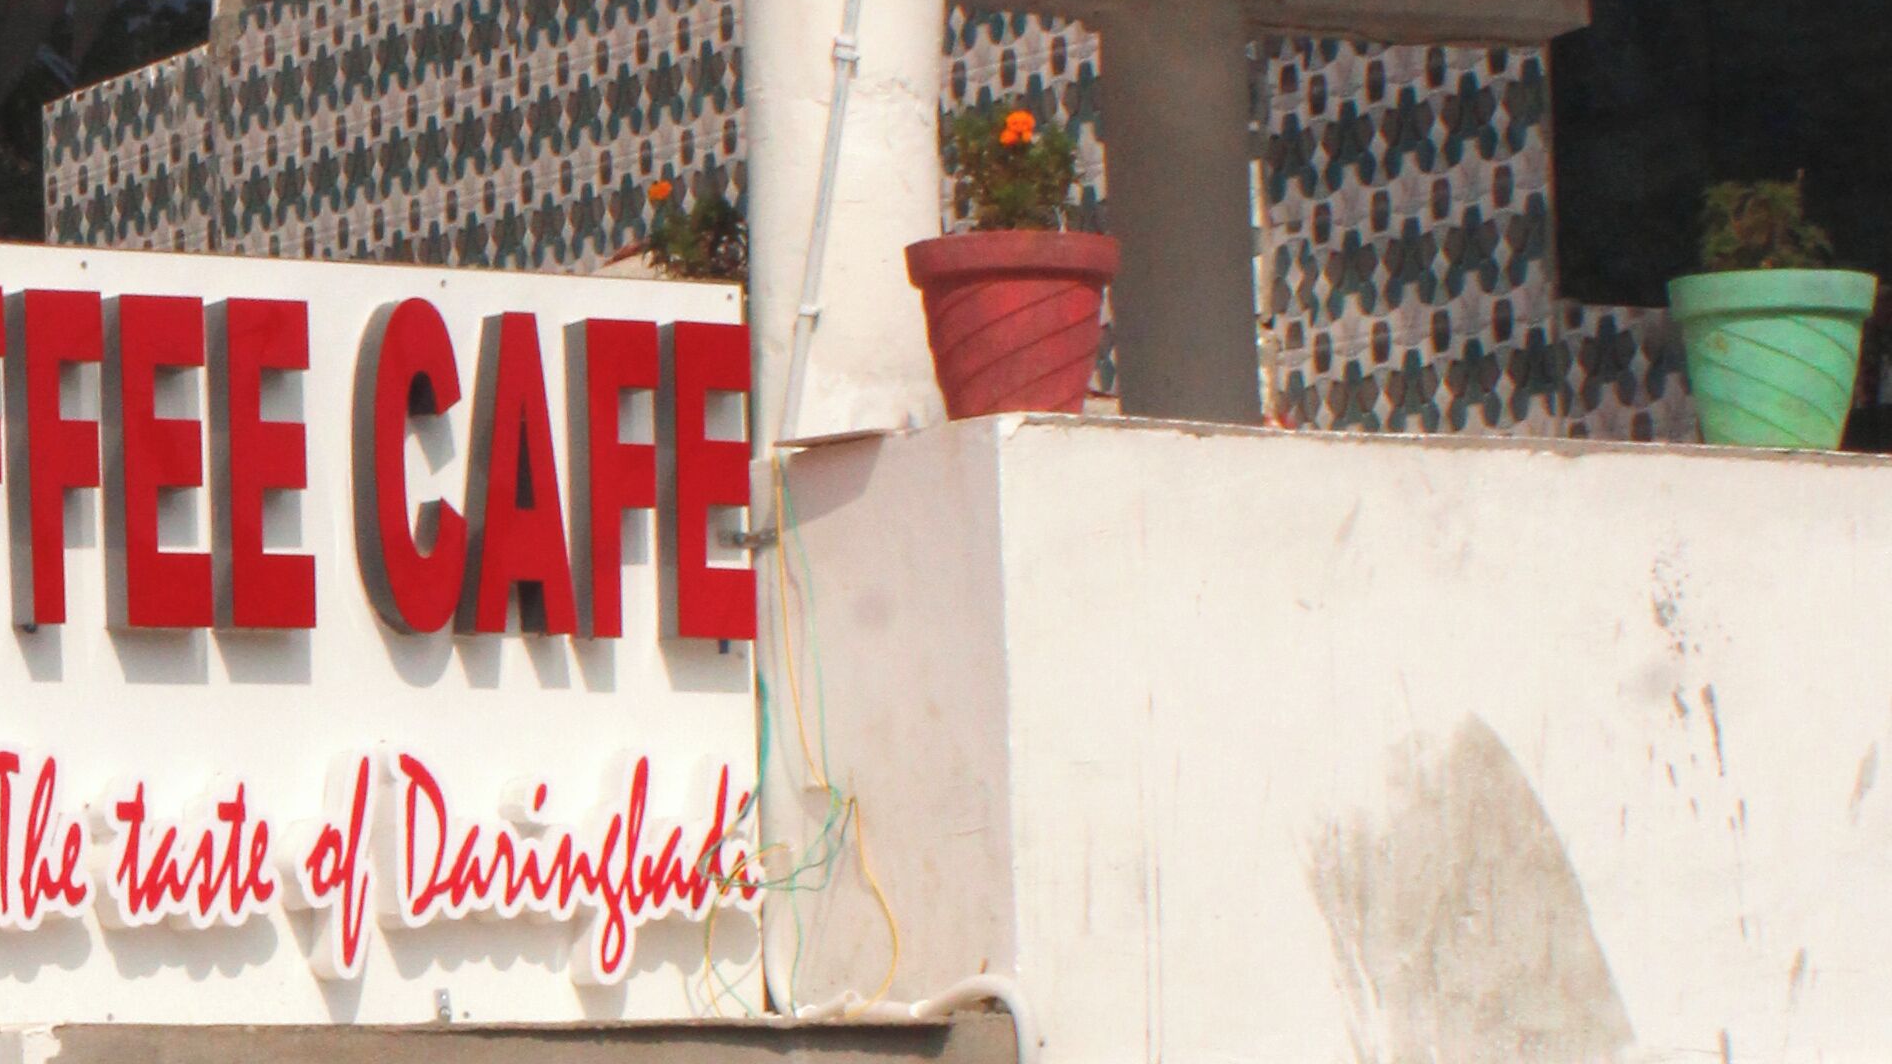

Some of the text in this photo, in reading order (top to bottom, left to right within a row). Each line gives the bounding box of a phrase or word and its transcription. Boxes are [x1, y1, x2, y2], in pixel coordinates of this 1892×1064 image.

[364, 297, 757, 642] CAFE
[115, 781, 275, 916] taste
[305, 755, 370, 968] of
[398, 753, 758, 974] Daringbadi
